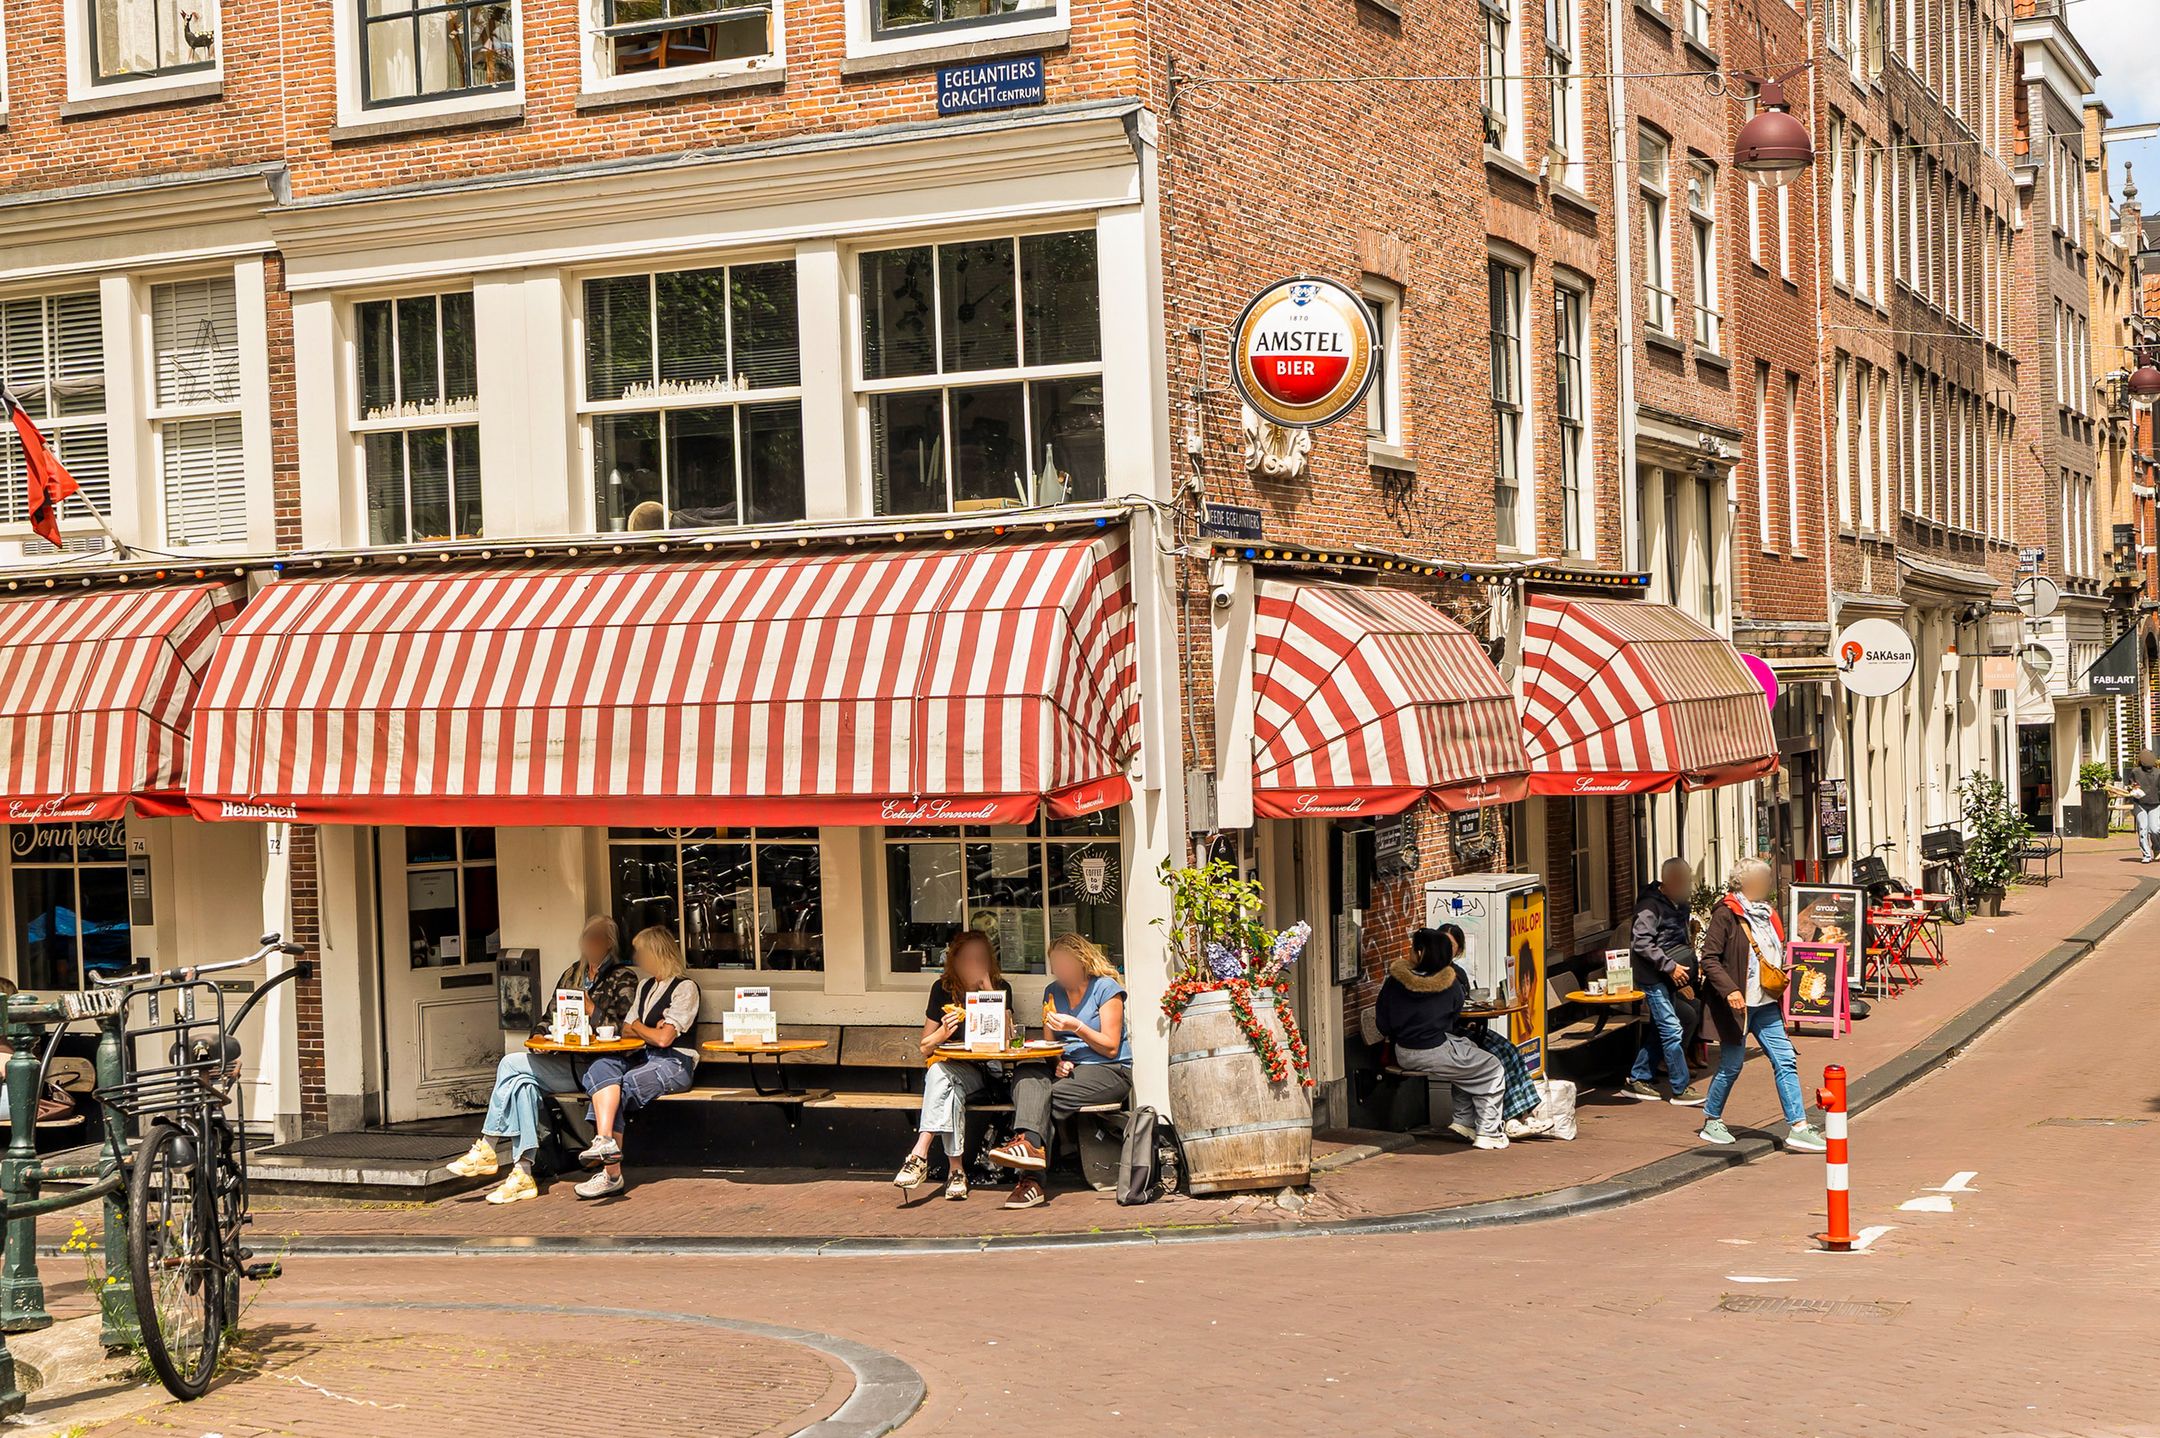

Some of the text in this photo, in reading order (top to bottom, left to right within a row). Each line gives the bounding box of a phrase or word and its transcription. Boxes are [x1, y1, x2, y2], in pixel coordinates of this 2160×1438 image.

[944, 62, 1036, 89] EGELANTIERS
[941, 86, 1040, 108] GRACHT CENTRUM
[1255, 331, 1343, 352] AMSTEL
[1276, 360, 1315, 376] BIER
[1341, 336, 1368, 400] GEBROUWEN
[1866, 650, 1911, 661] SAKAsan
[2093, 675, 2136, 684] FABI.ART
[1571, 776, 1632, 792] Sonneveld
[220, 801, 298, 818] Heineken
[926, 799, 998, 819] Sonneveld
[1292, 794, 1366, 813] Sonneveld
[133, 841, 144, 851] 74
[269, 839, 281, 850] 72
[1085, 868, 1103, 877] COFFEE
[1815, 905, 1839, 913] GYOZA
[1516, 914, 1529, 936] VAL
[1529, 911, 1541, 931] OP!
